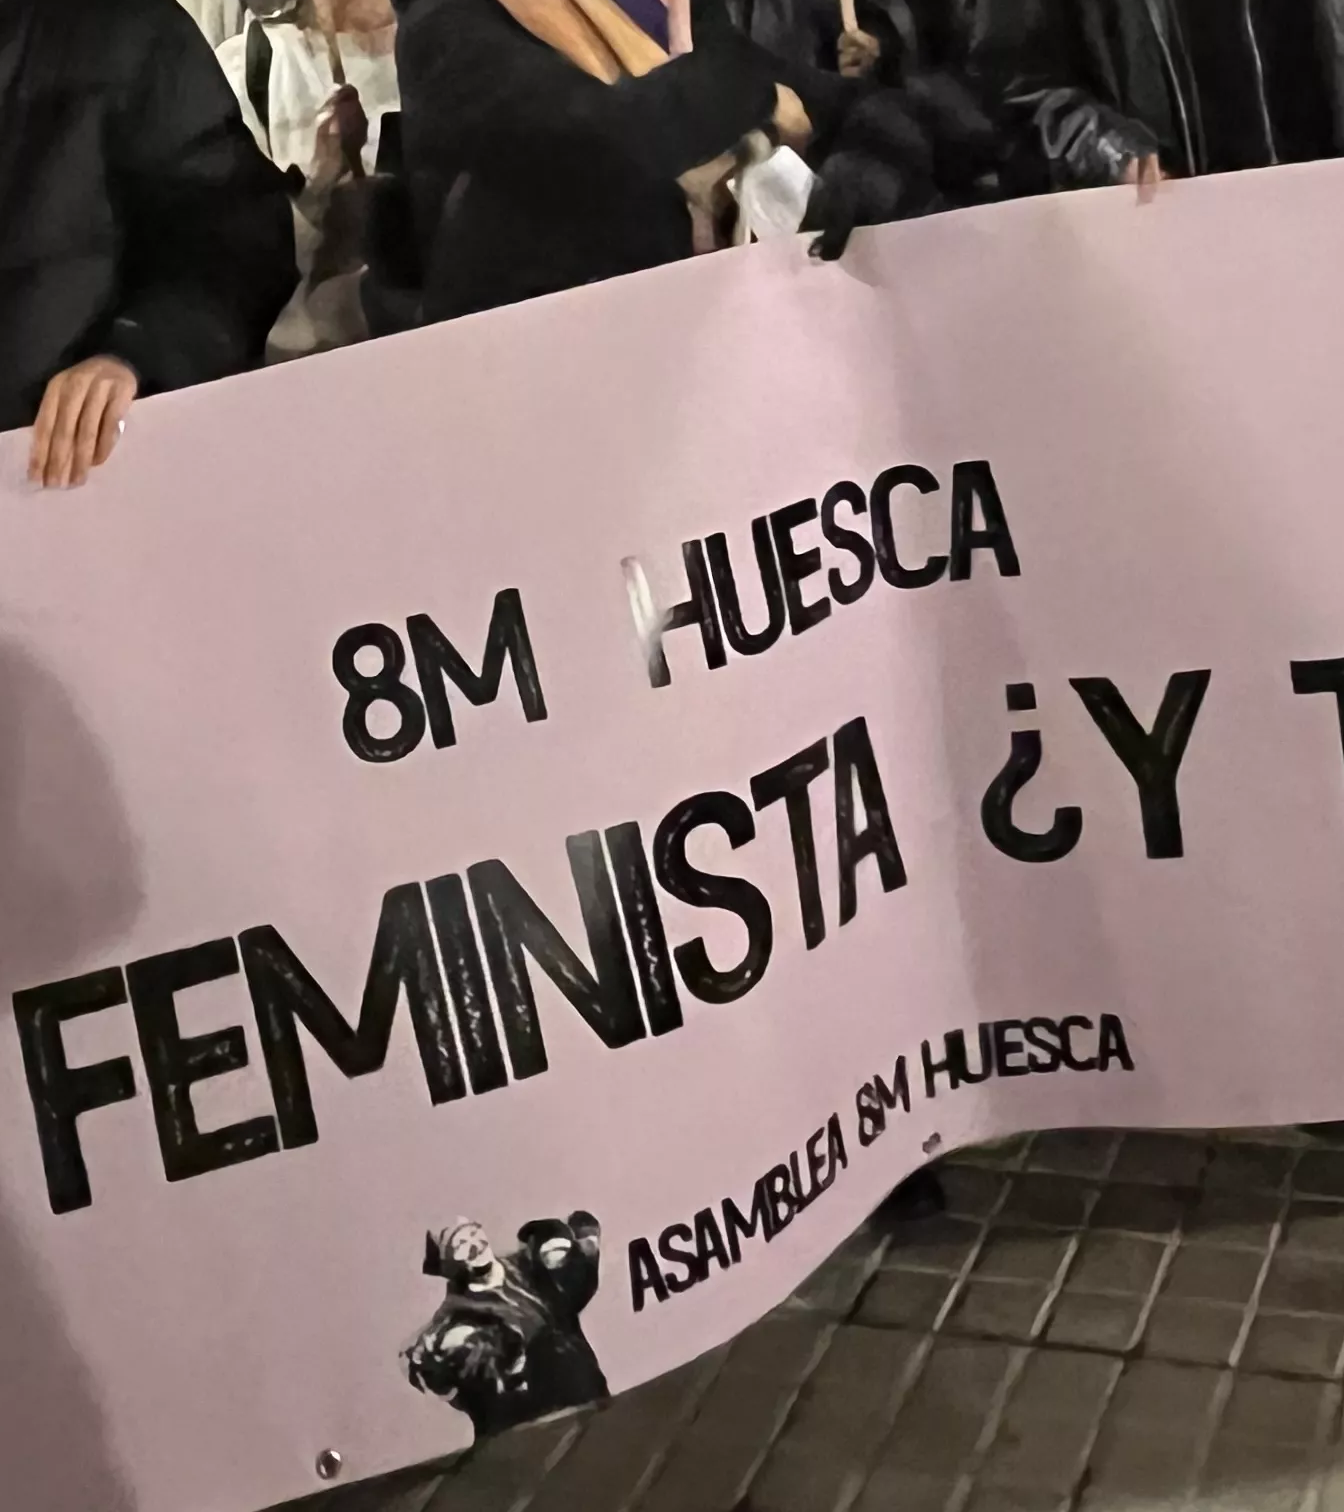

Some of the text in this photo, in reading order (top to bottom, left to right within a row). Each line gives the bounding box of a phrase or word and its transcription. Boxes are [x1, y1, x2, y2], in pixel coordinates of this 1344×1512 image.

[332, 458, 1021, 763] 8M HUESCA
[12, 716, 908, 1215] FEMINISTA
[980, 668, 1211, 864] ¿Y
[628, 1013, 1135, 1312] ASAMBLEA 8M HUESCA
